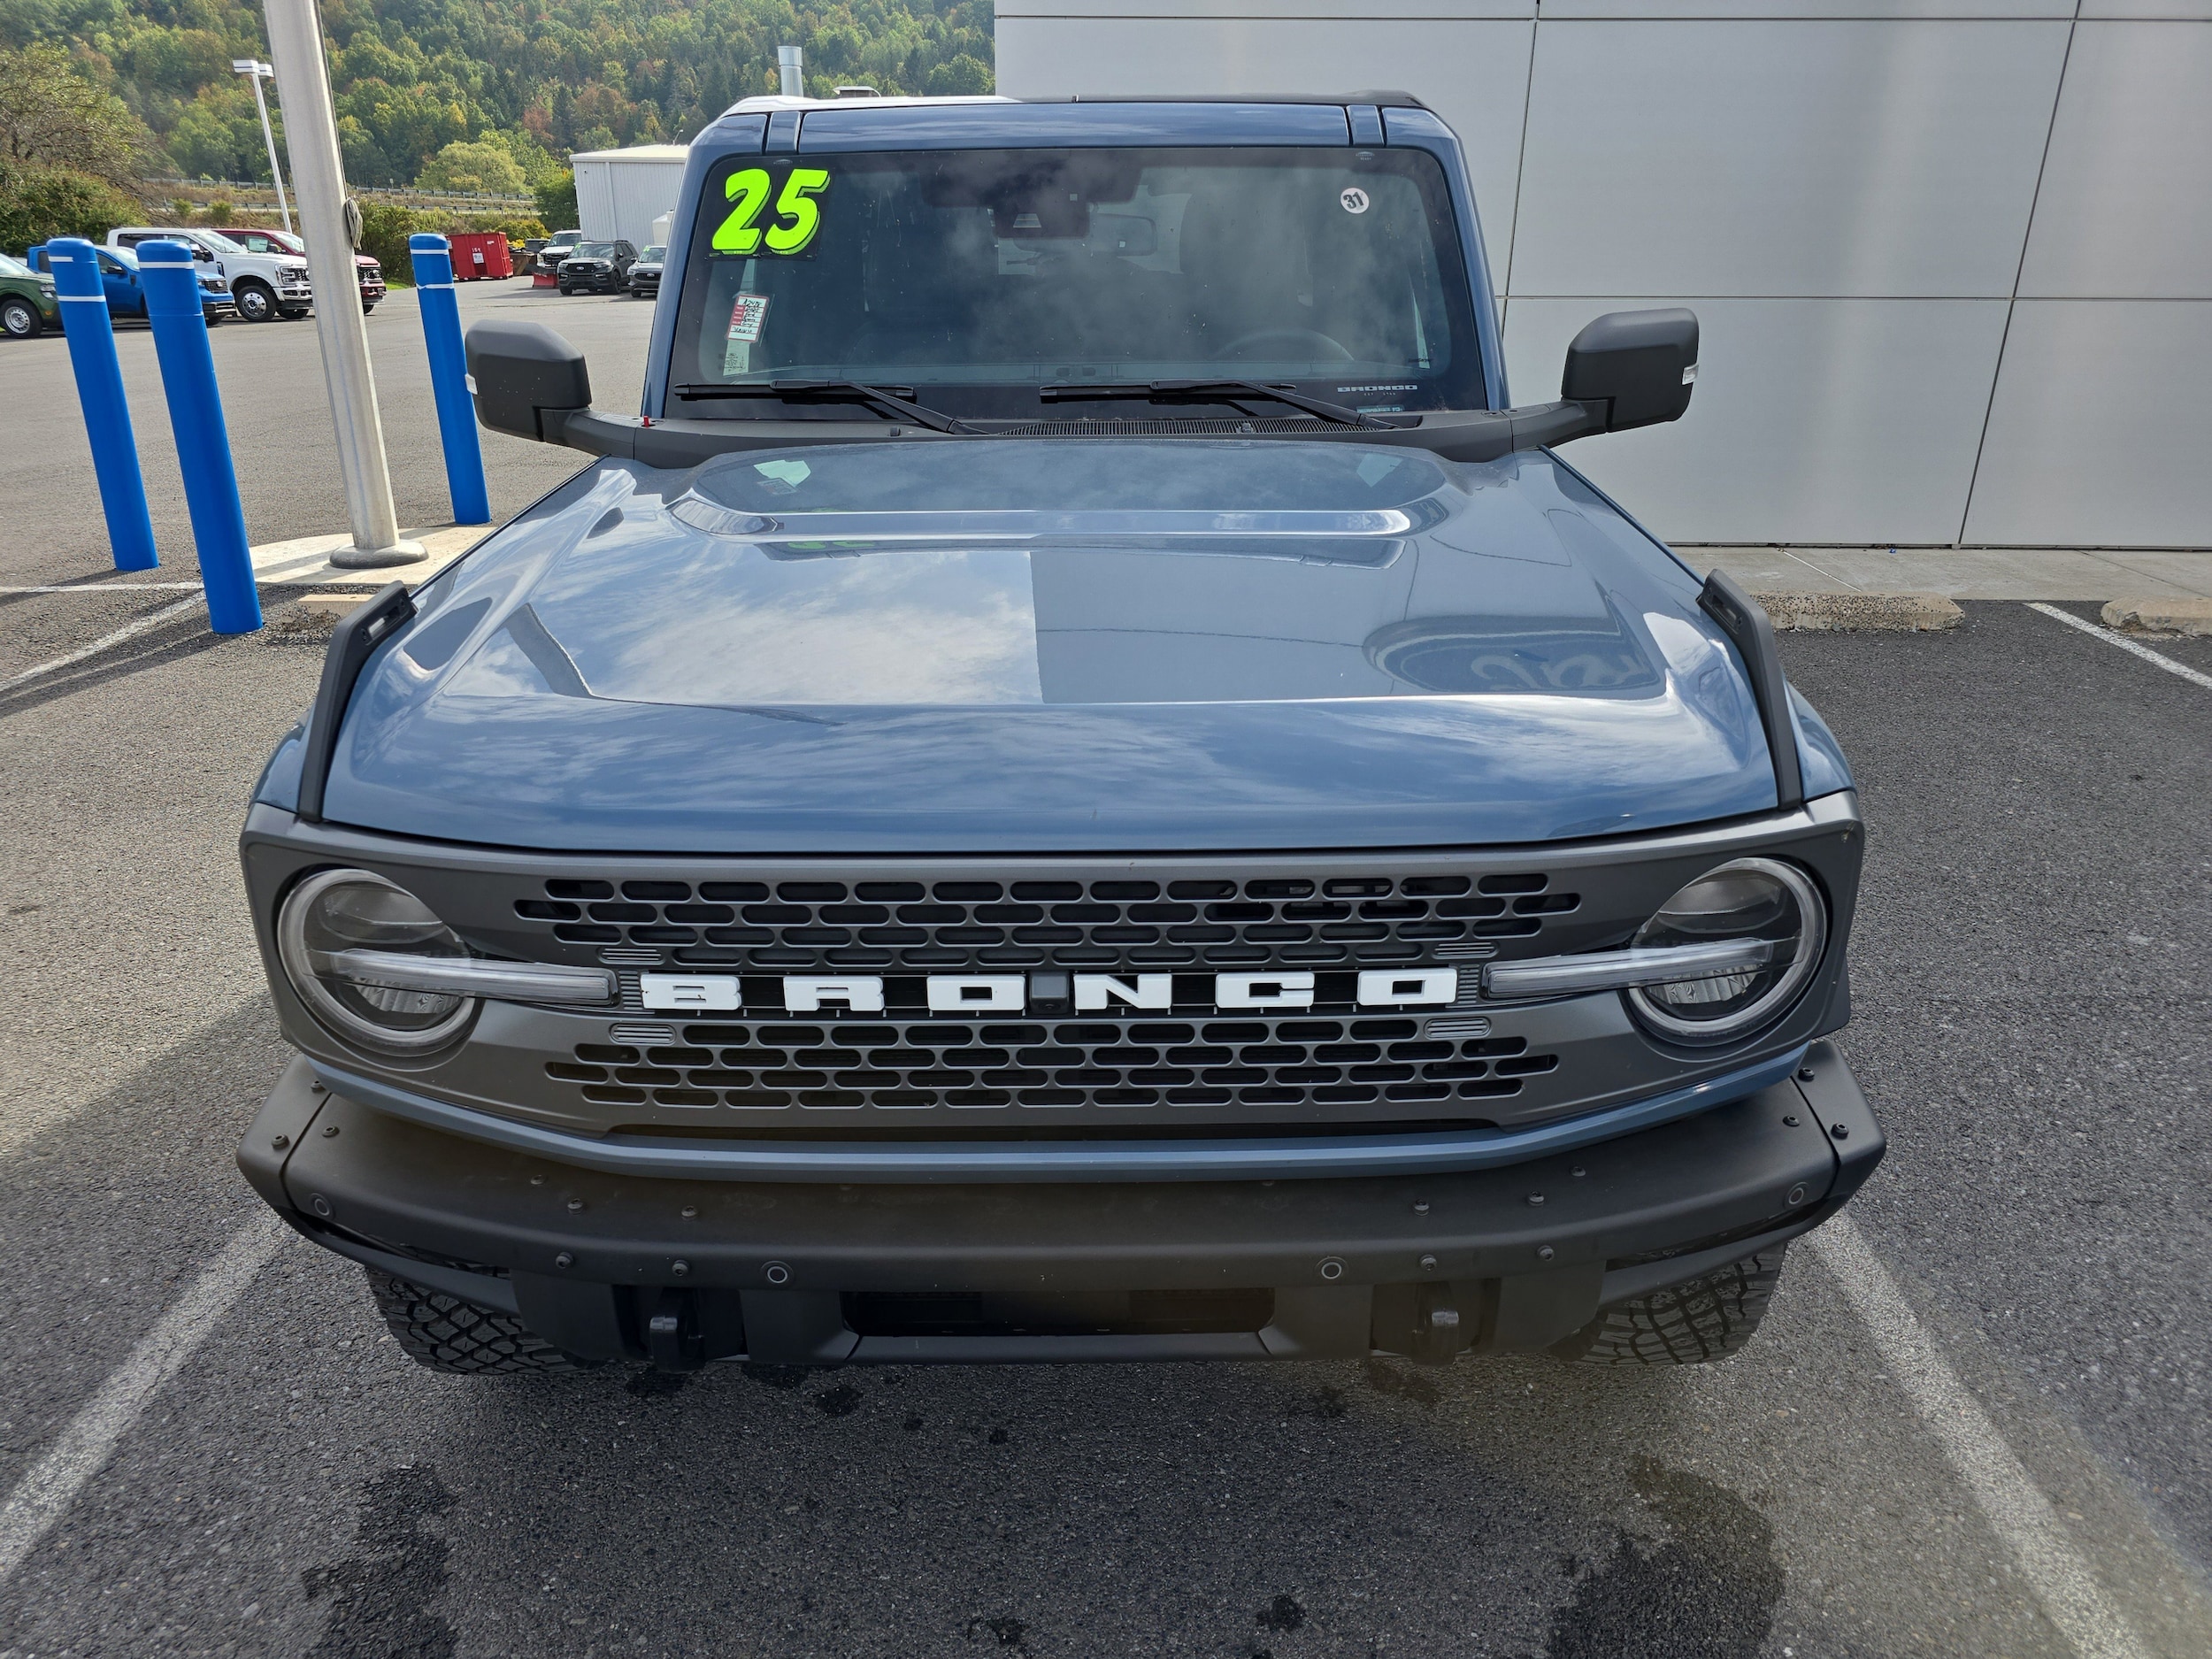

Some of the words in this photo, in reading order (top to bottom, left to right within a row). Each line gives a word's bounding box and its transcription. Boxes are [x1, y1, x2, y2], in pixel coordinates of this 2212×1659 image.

[712, 168, 831, 255] 25
[1343, 191, 1364, 210] 31
[641, 967, 1458, 1011] BRONCO
